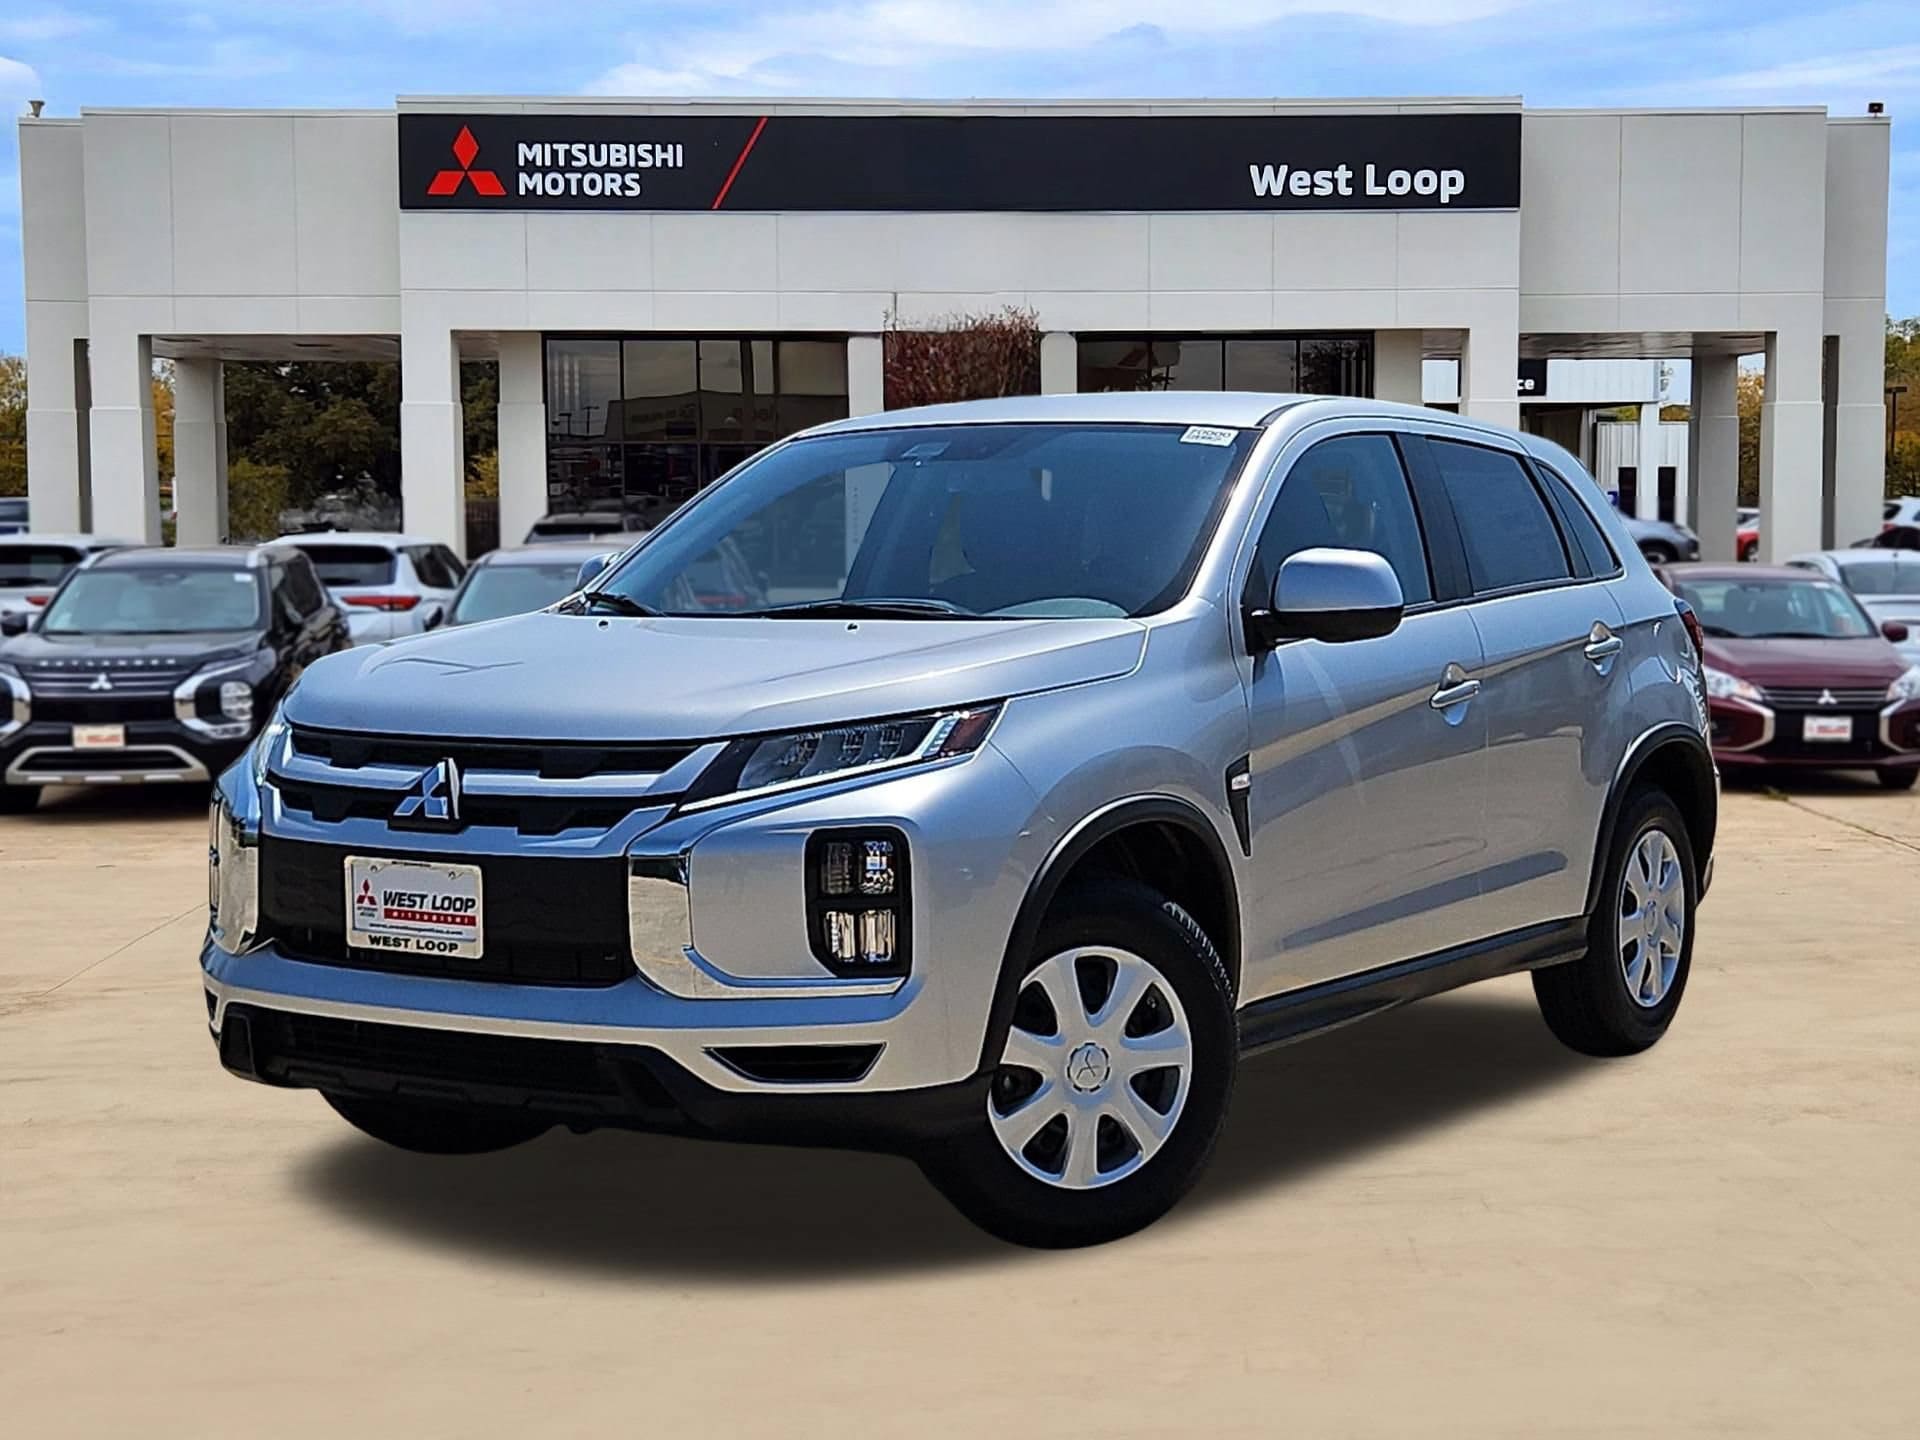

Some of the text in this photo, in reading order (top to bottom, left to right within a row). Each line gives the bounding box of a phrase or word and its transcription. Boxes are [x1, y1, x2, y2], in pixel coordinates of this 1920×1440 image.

[517, 142, 683, 169] MITSUBISHI
[518, 172, 641, 197] MOTORS
[1249, 163, 1465, 204] West Loop
[383, 890, 476, 913] WEST LOOP
[368, 934, 459, 953] WEST LOOP
